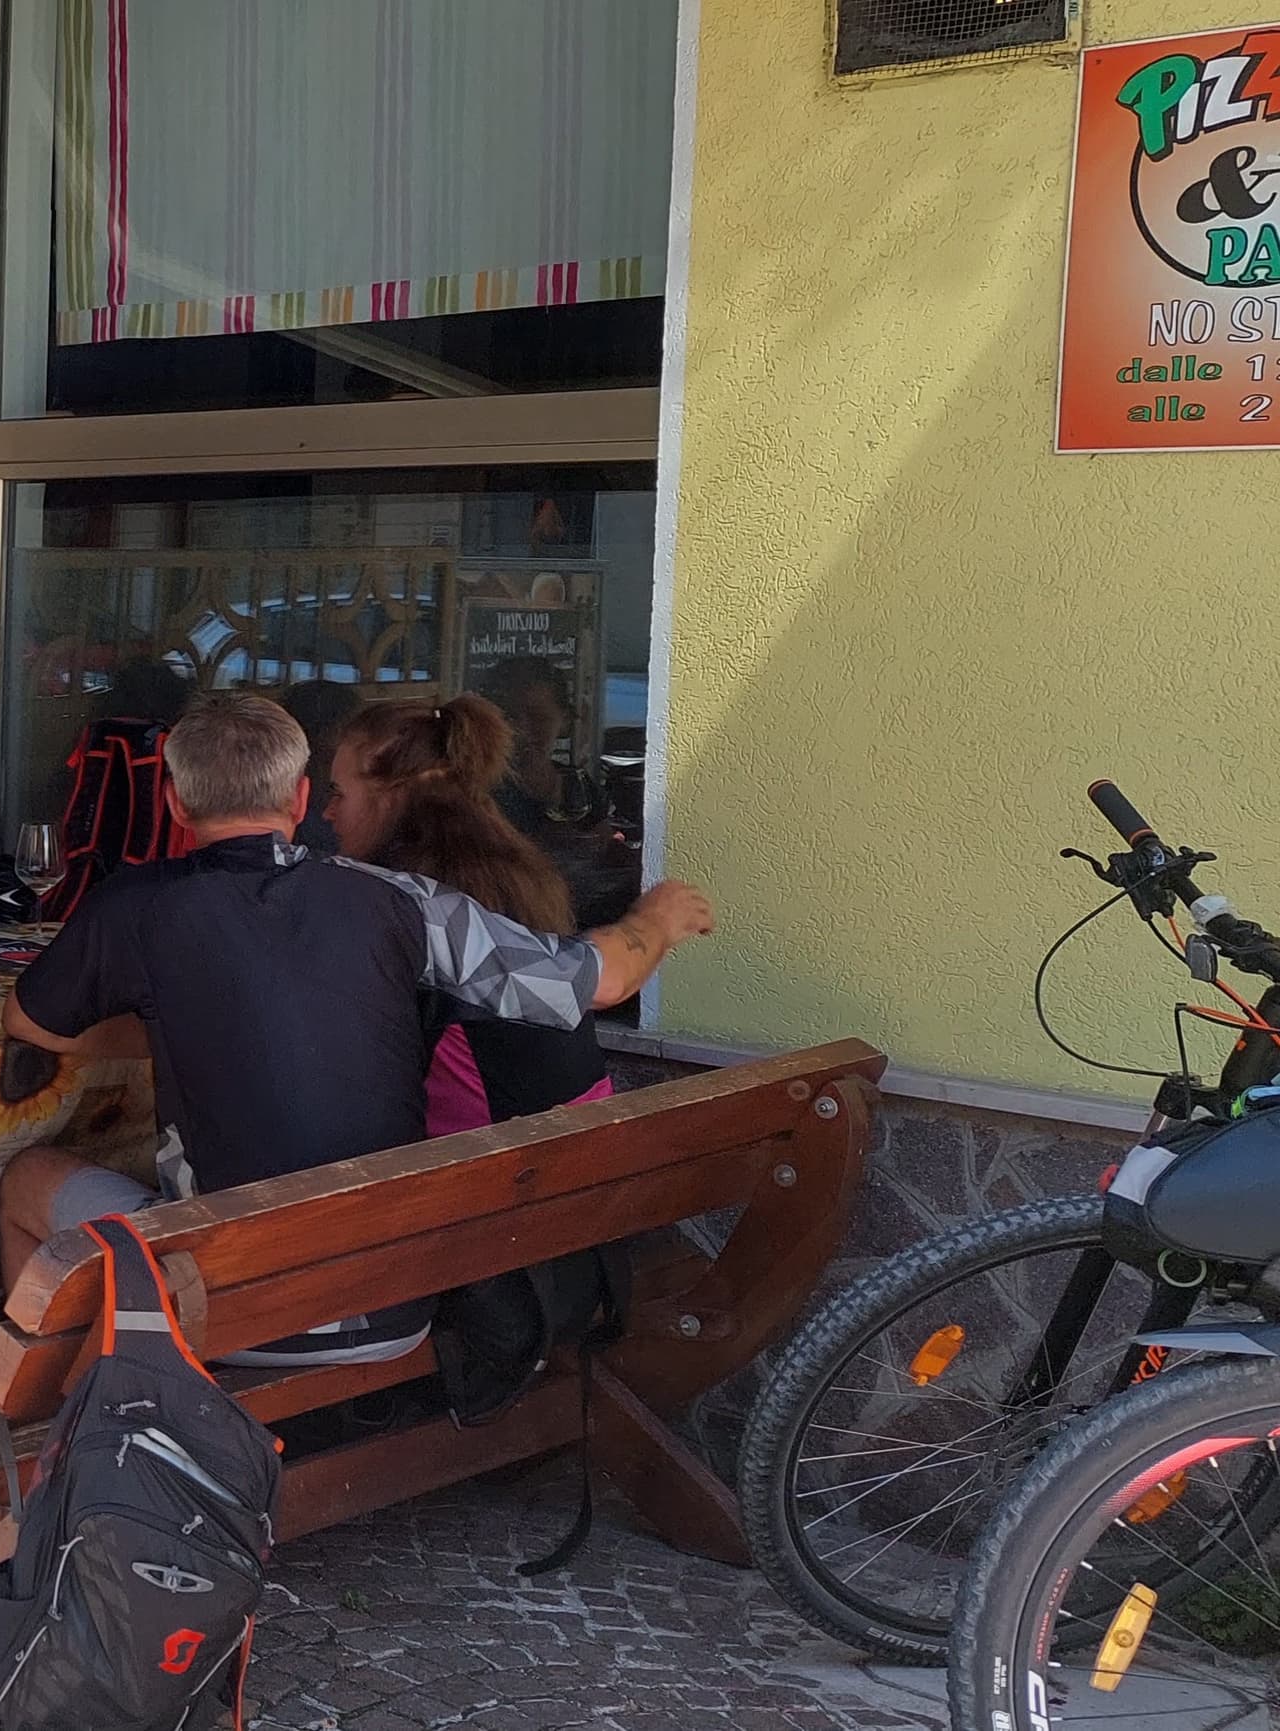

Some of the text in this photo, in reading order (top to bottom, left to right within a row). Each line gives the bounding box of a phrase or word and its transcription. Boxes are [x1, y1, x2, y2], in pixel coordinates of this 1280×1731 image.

[1177, 146, 1280, 223] &
[1149, 299, 1216, 346] NO
[1116, 353, 1280, 384] dalle 1
[1127, 396, 1206, 422] alle
